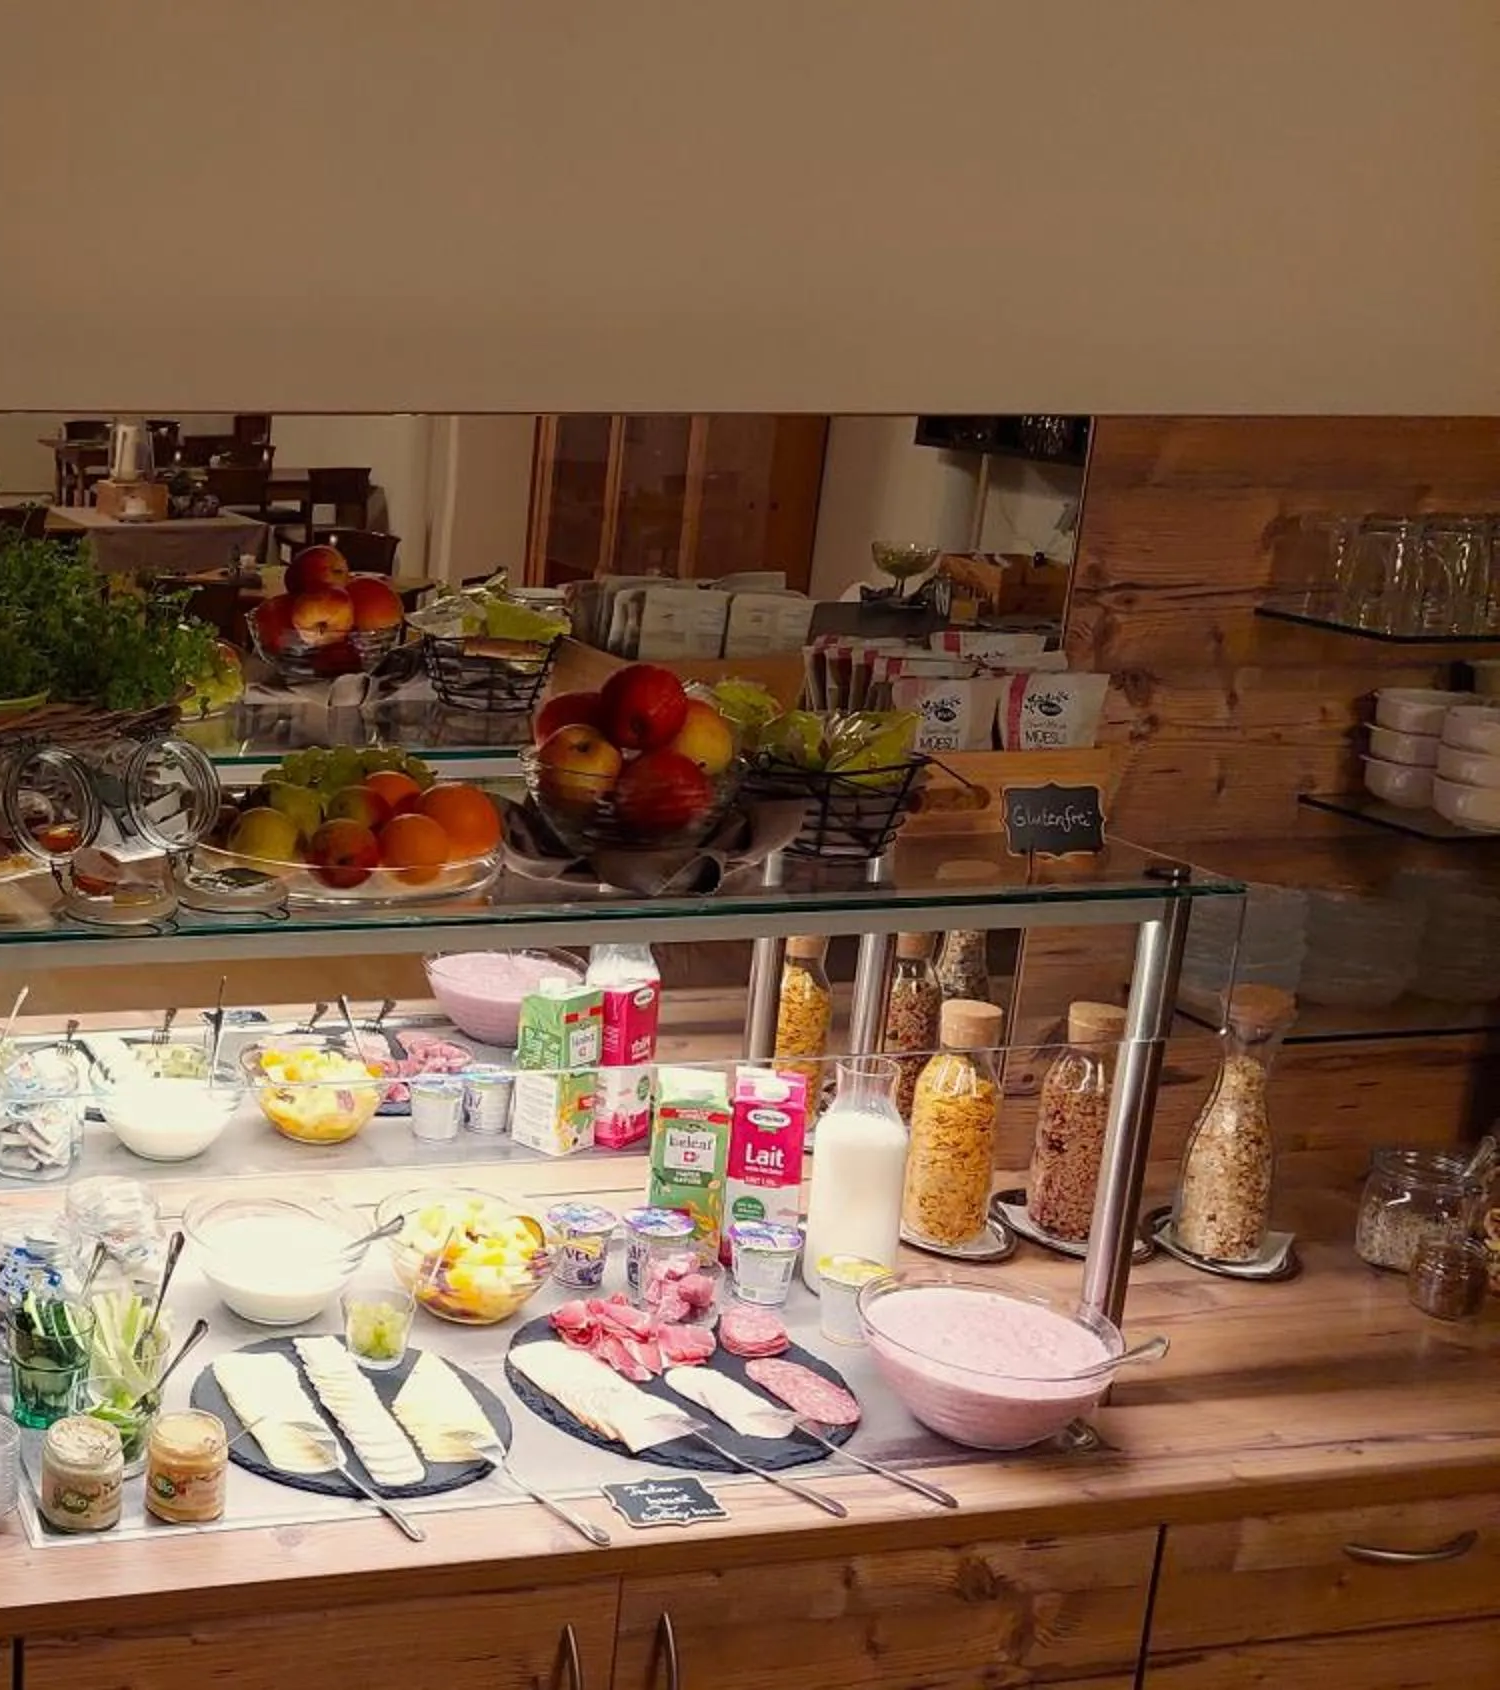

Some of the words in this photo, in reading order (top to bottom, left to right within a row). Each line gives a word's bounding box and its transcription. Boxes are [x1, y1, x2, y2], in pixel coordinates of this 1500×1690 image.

[1012, 804, 1093, 833] Glutenfrei
[668, 1133, 714, 1151] beleaf
[745, 1142, 786, 1169] Lait
